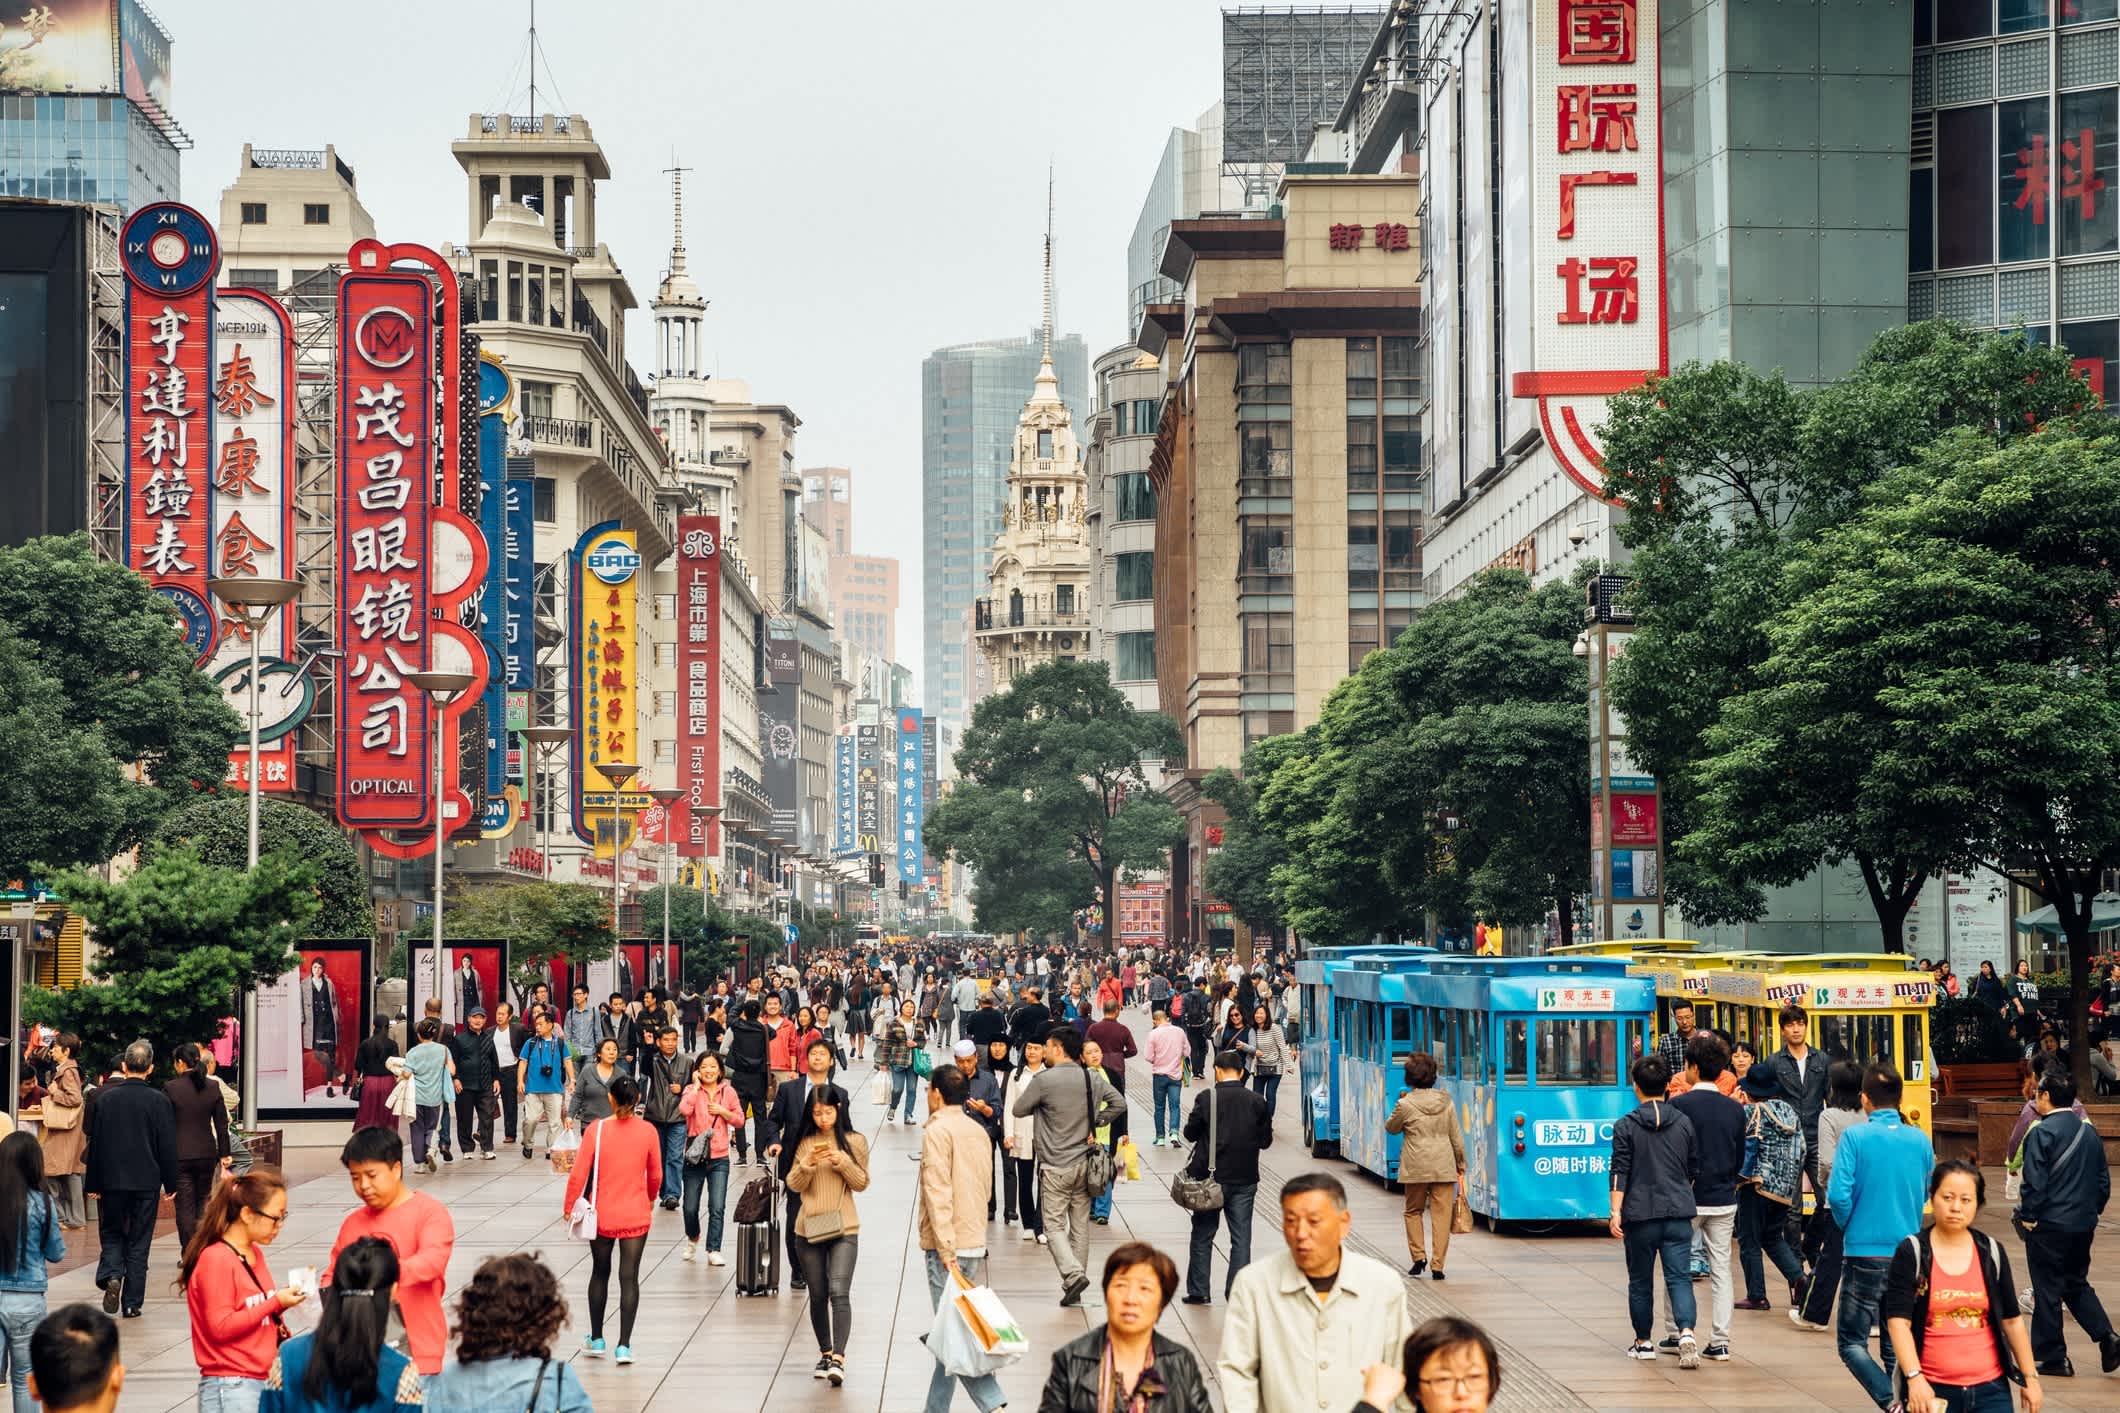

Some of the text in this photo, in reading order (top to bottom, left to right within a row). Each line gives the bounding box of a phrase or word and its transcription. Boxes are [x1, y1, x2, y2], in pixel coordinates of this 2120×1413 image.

[158, 212, 178, 223] XII
[1329, 223, 1409, 252] 新雅
[128, 242, 144, 253] IX
[194, 244, 209, 255] III
[160, 273, 177, 286] VI
[587, 554, 641, 568] BAC
[350, 381, 419, 756] 茂昌眼镜公司
[691, 746, 705, 774] First
[350, 779, 417, 795] OPTICAL
[1564, 989, 1612, 1001] 观光车
[1837, 987, 1885, 999] 观光车
[1914, 1063, 1921, 1079] 7
[1543, 1125, 1586, 1143] 脉动
